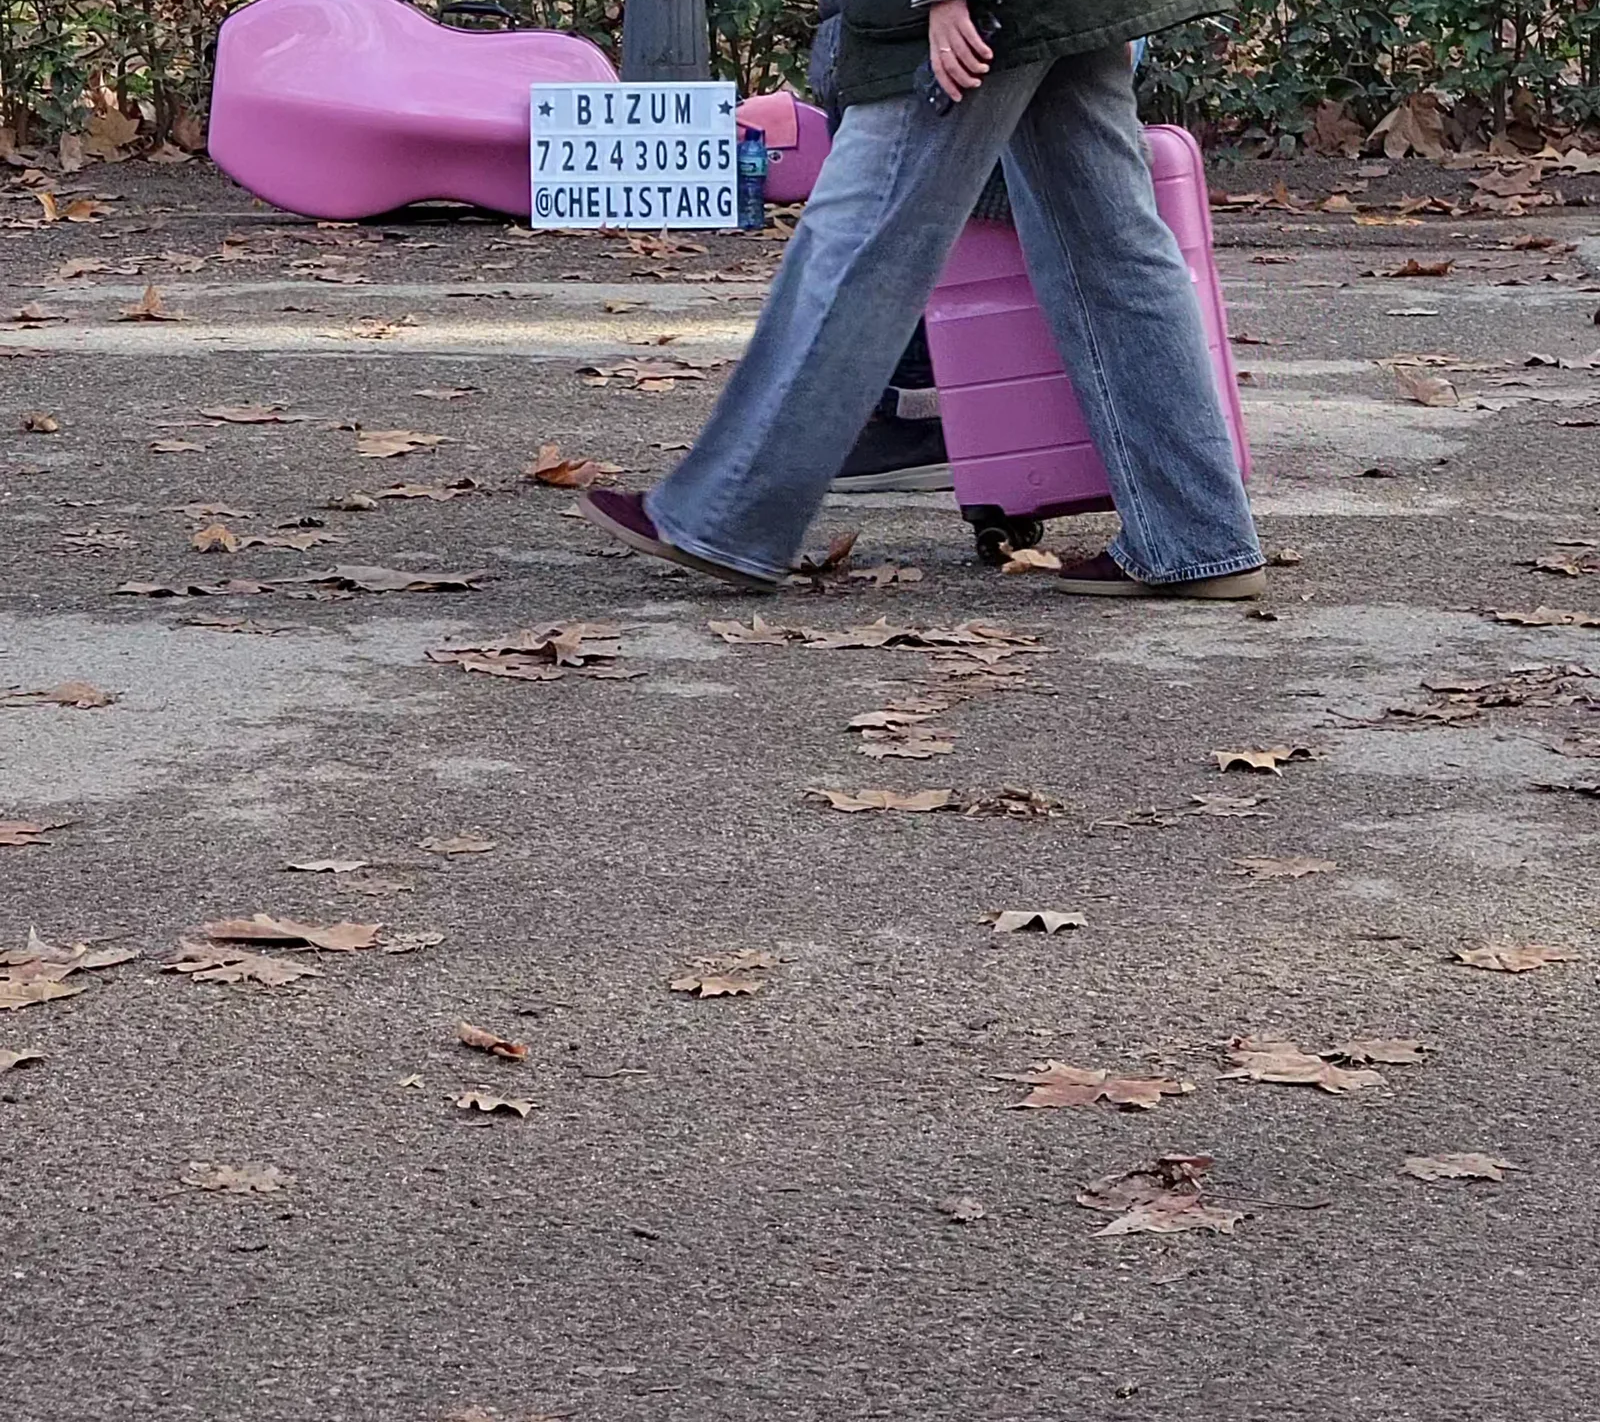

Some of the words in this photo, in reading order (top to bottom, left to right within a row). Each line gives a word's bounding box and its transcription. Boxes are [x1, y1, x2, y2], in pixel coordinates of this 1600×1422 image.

[577, 93, 692, 125] BIZUM
[537, 139, 731, 172] 722430365
[535, 186, 733, 218] @CHELISTARG
